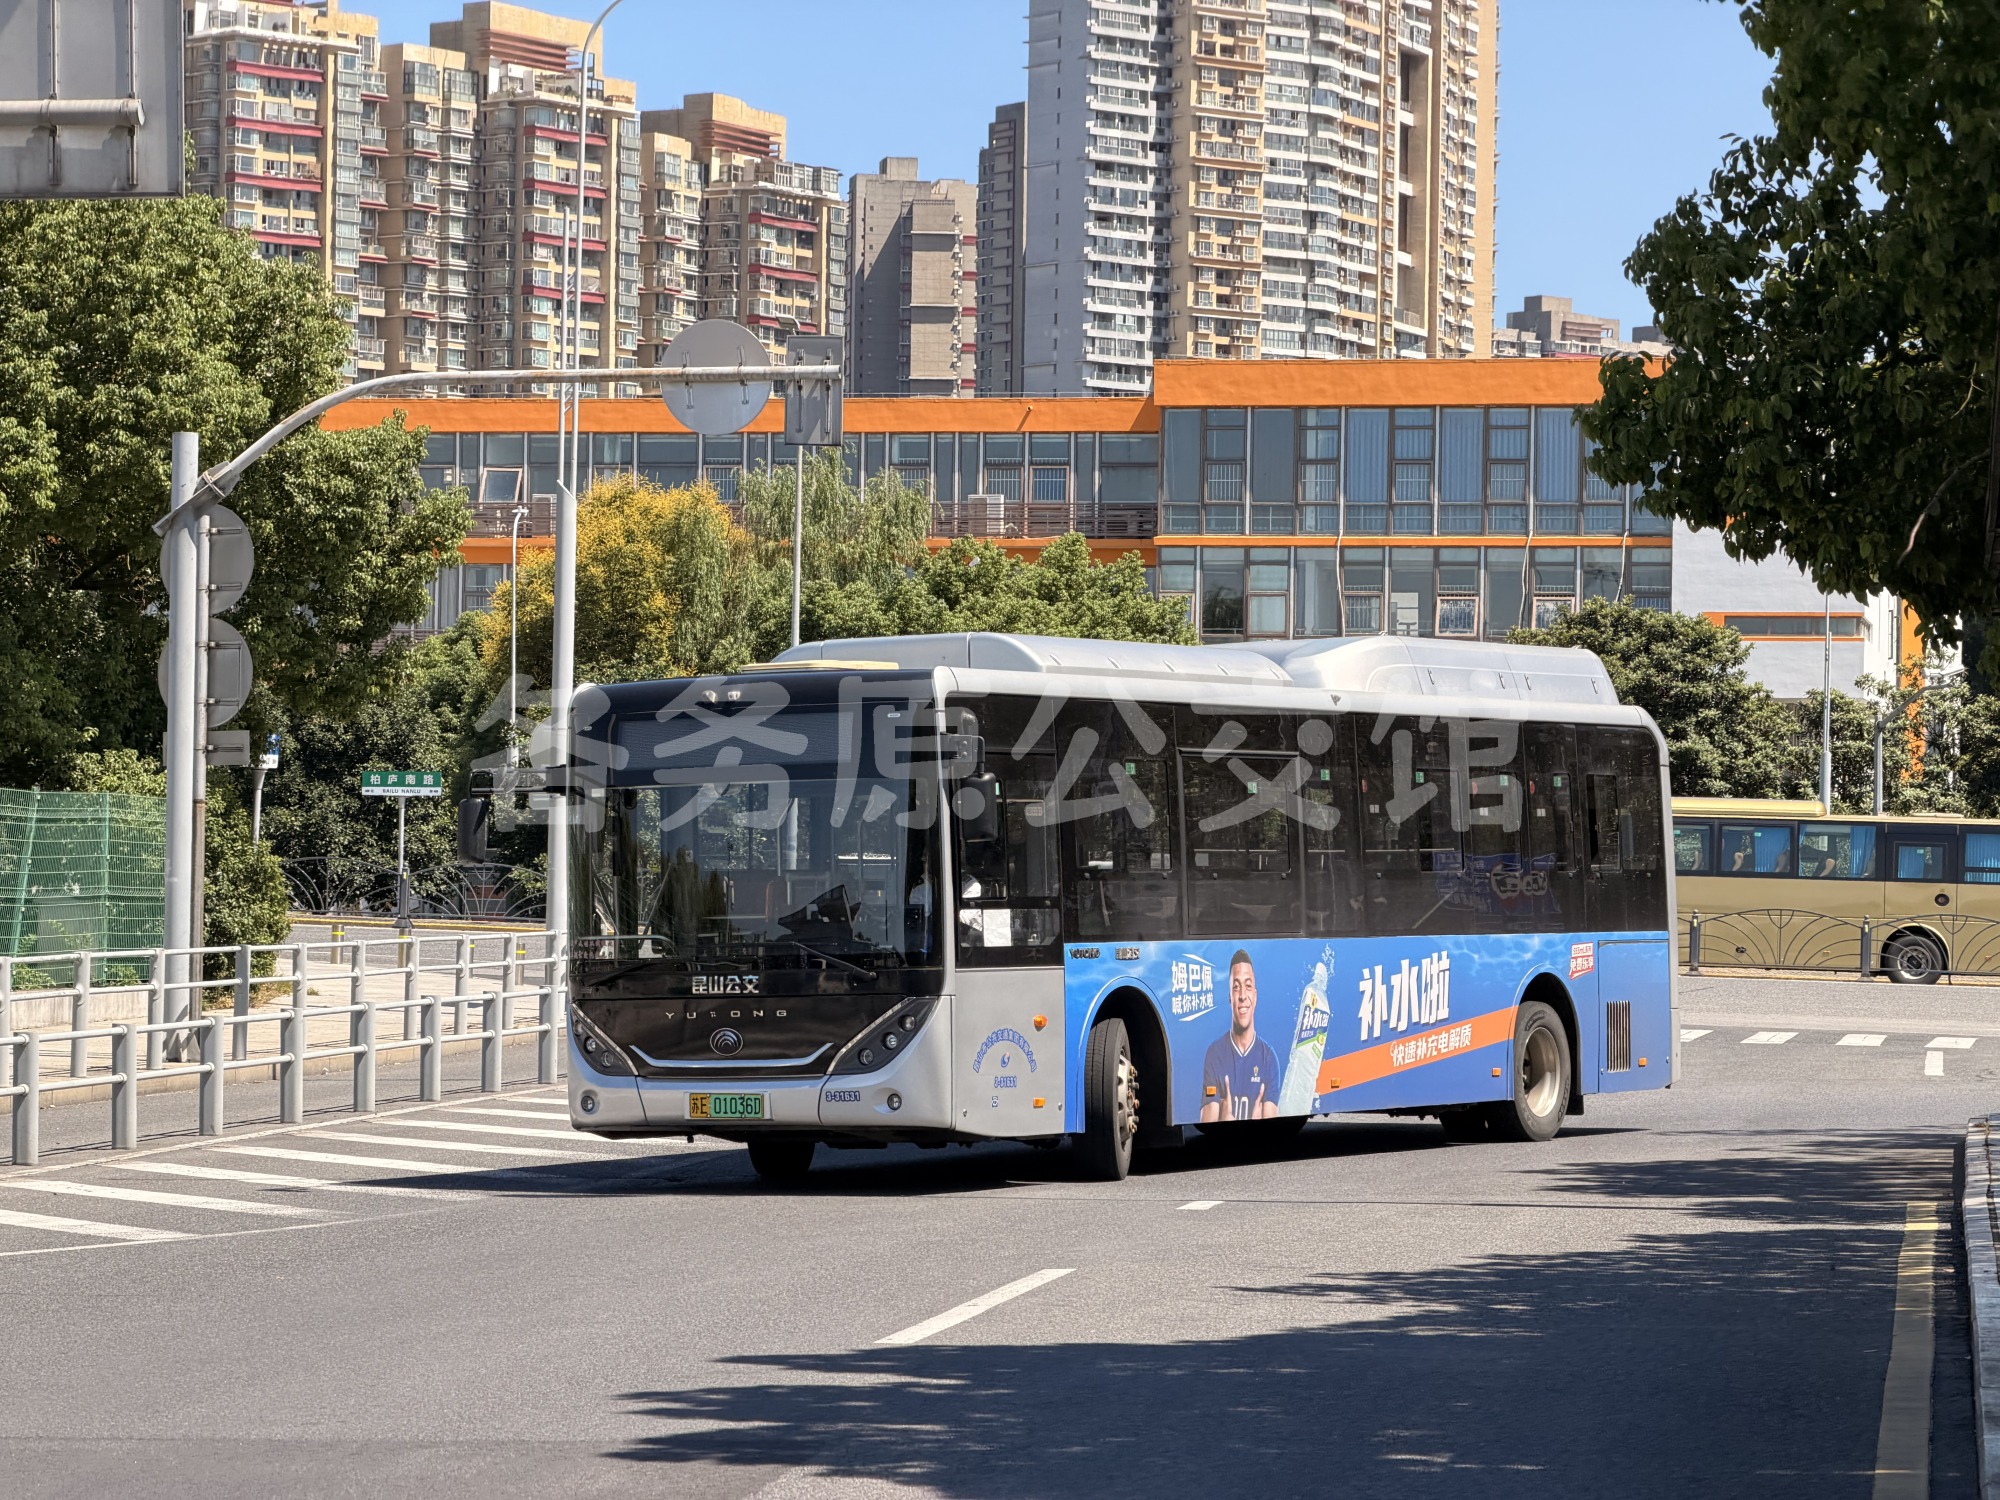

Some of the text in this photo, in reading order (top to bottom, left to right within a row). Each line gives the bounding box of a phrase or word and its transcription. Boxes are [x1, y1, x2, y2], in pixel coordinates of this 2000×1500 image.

[370, 774, 434, 785] 柏庐南路
[692, 975, 760, 994] 昆山公交
[1172, 960, 1213, 993] 姆巴佩
[1172, 992, 1214, 1015] 喊你补水啦
[1358, 950, 1450, 1041] 补水啦
[1303, 1006, 1329, 1030] 补水啦
[1392, 1023, 1472, 1067] 快速补充电解质
[826, 1091, 861, 1102] 3-31631
